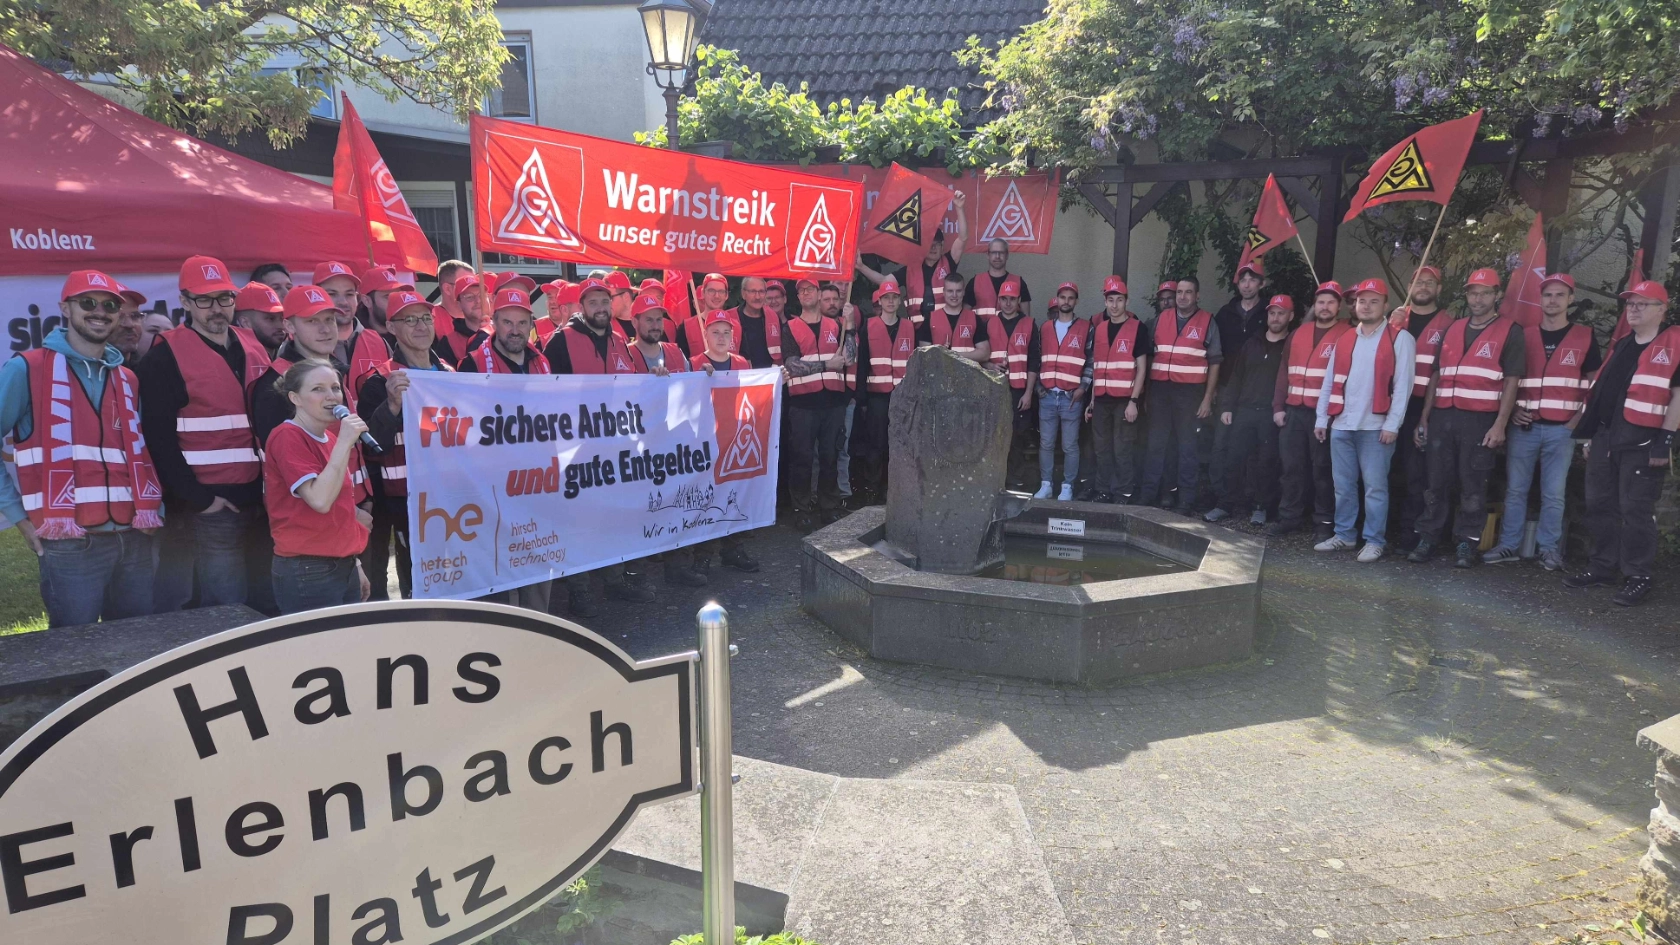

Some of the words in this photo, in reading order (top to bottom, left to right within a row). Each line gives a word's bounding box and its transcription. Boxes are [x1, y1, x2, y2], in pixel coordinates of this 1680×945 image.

[602, 168, 776, 227] Warnstreik
[9, 228, 96, 250] Koblenz
[599, 223, 660, 246] unser
[663, 230, 717, 253] gutes
[722, 232, 773, 256] Recht
[419, 406, 473, 448] Für
[479, 404, 574, 446] sichere
[578, 401, 646, 439] Arbeit
[506, 456, 559, 497] und
[564, 455, 616, 499] gute
[619, 441, 711, 486] Entgelte!
[418, 491, 484, 544] he
[510, 517, 538, 537] hirsch
[643, 523, 664, 539] Wir
[667, 522, 678, 534] in
[508, 530, 559, 553] erlenbach
[420, 551, 468, 574] hetech
[508, 548, 566, 569] technology
[423, 570, 464, 593] group
[173, 649, 501, 760] Hans
[0, 710, 634, 915] Erlenbach
